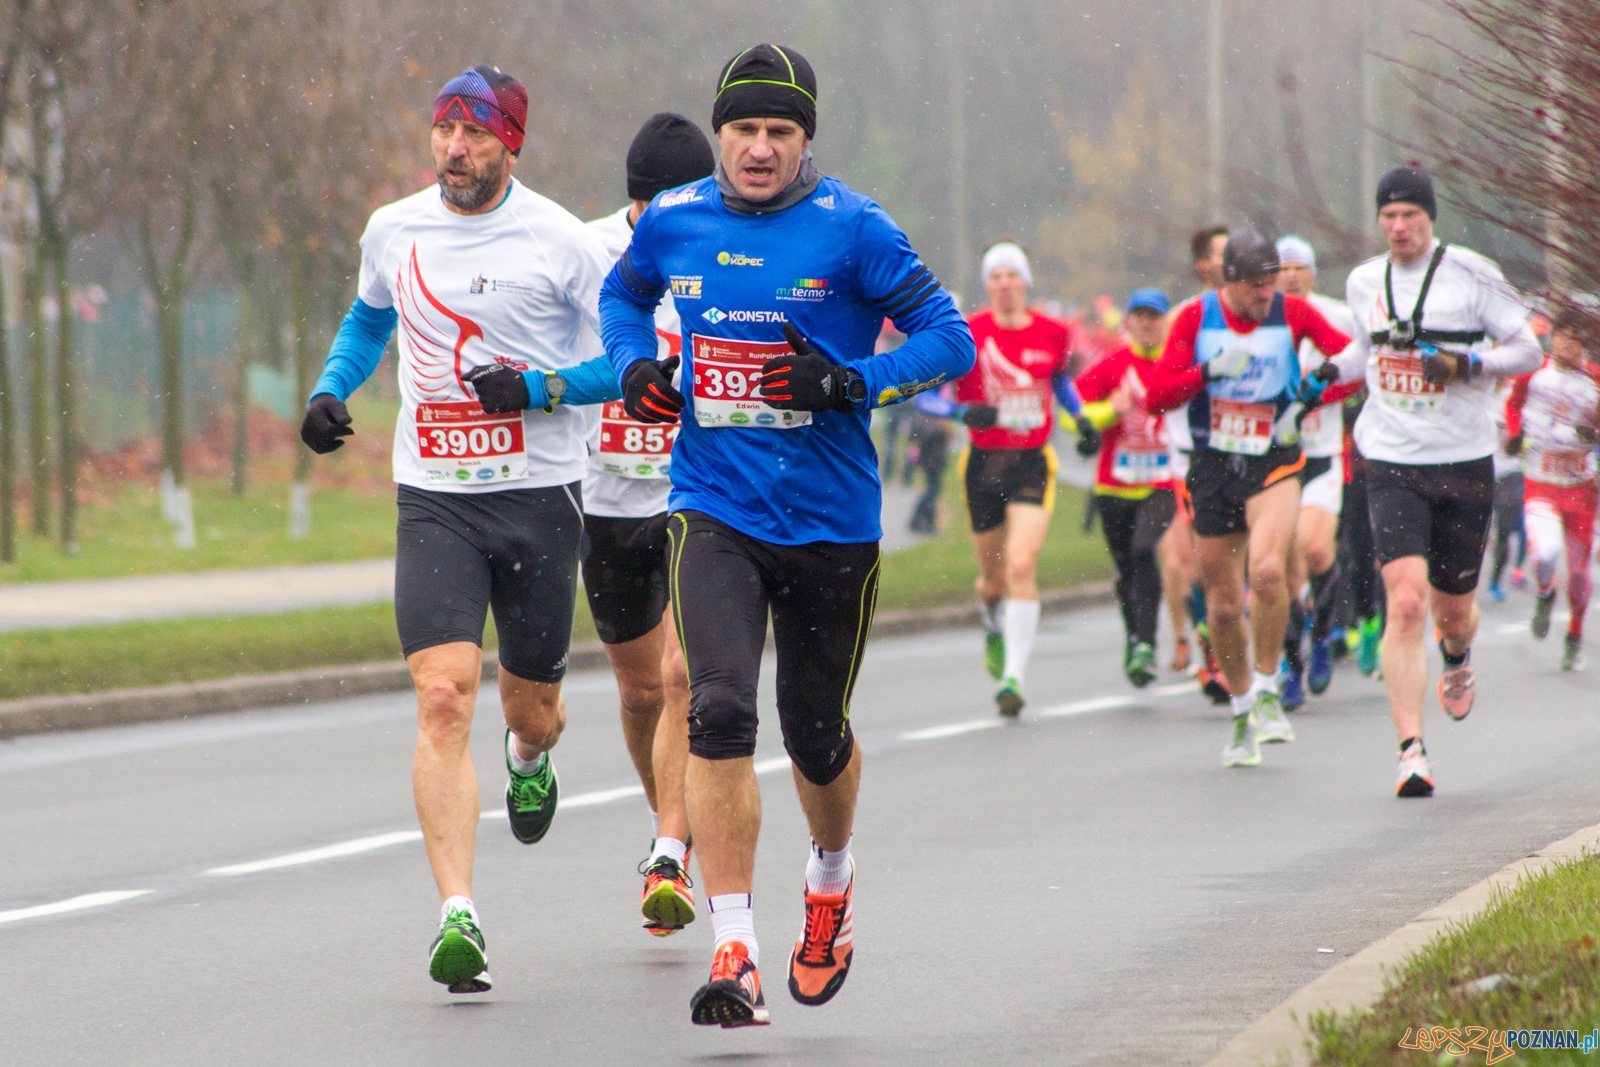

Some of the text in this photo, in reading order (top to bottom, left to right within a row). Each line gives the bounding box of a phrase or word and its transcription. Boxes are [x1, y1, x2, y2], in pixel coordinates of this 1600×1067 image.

[728, 310, 788, 323] KONSTAL
[695, 374, 702, 385] B
[420, 426, 512, 456] B 3900
[602, 432, 611, 443] B
